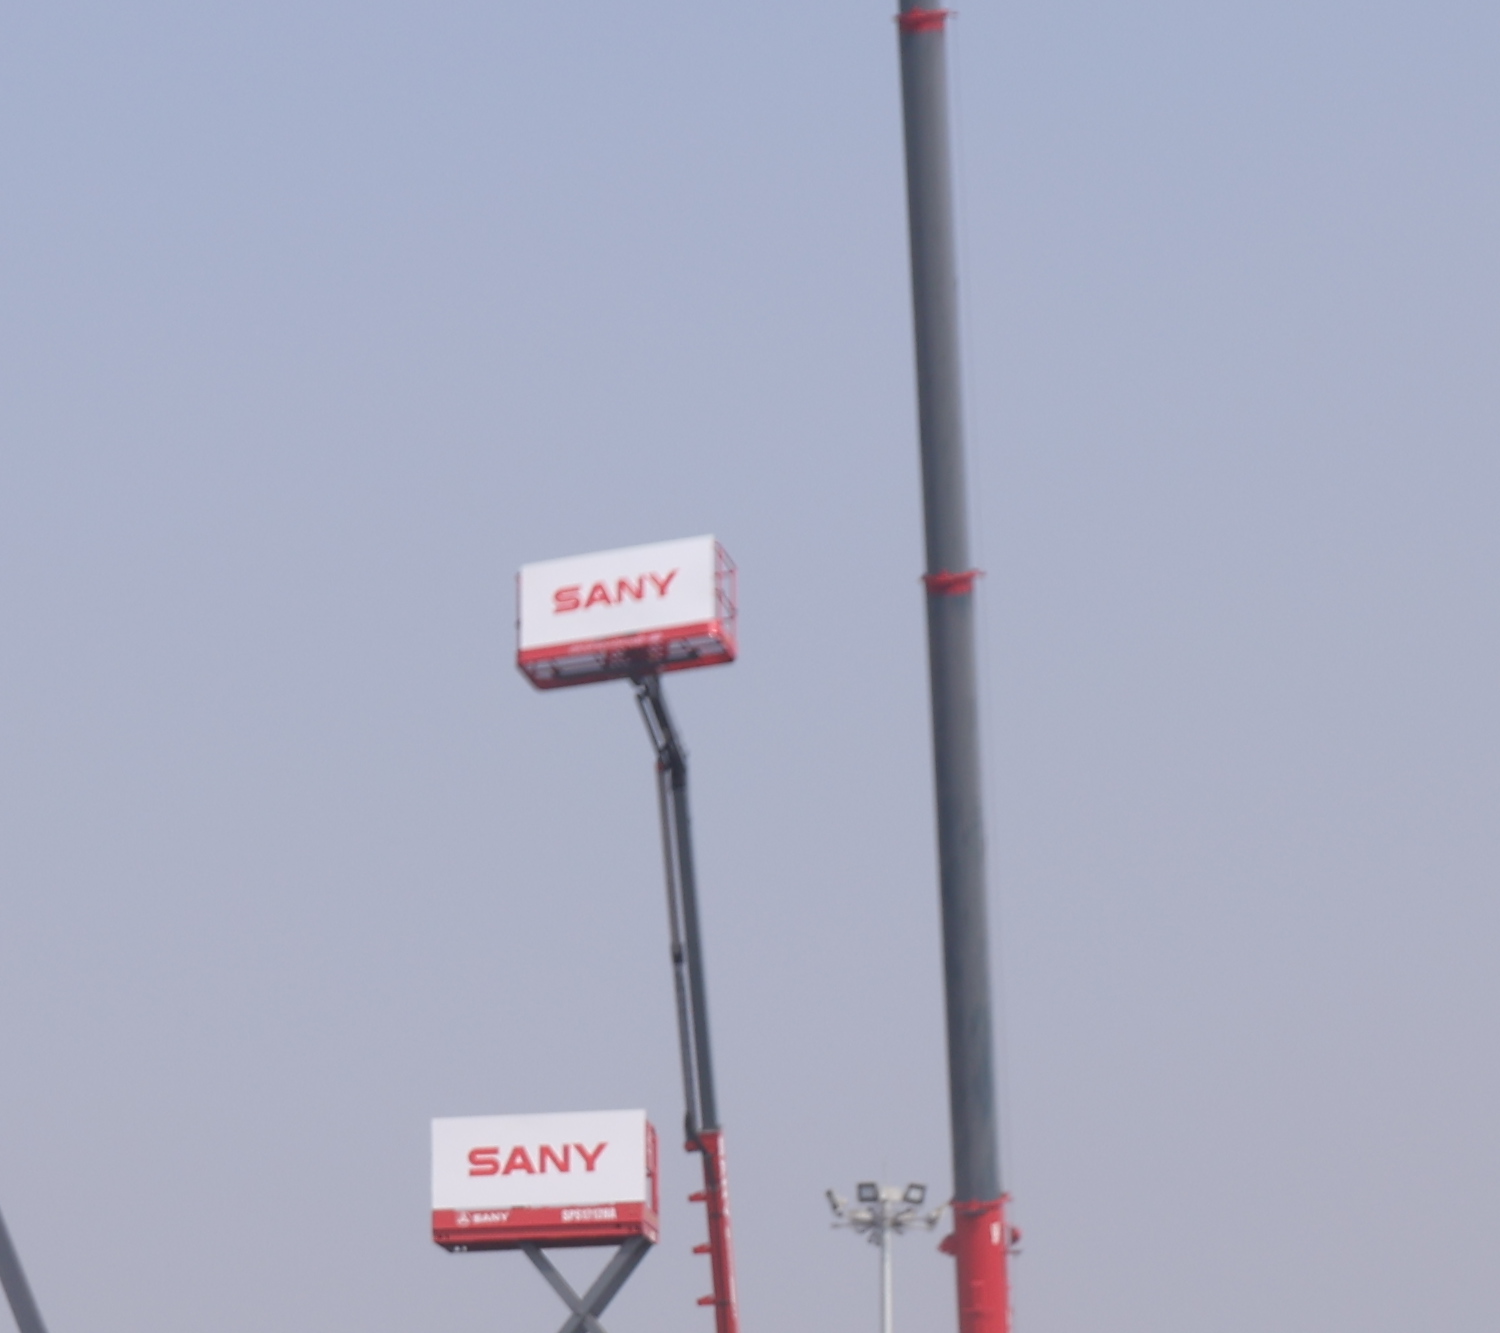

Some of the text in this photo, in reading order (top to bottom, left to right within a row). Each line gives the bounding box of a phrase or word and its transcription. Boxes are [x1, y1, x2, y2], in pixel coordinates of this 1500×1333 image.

[552, 567, 680, 615] SANY
[467, 1141, 609, 1176] SANY
[471, 1212, 511, 1224] SANY
